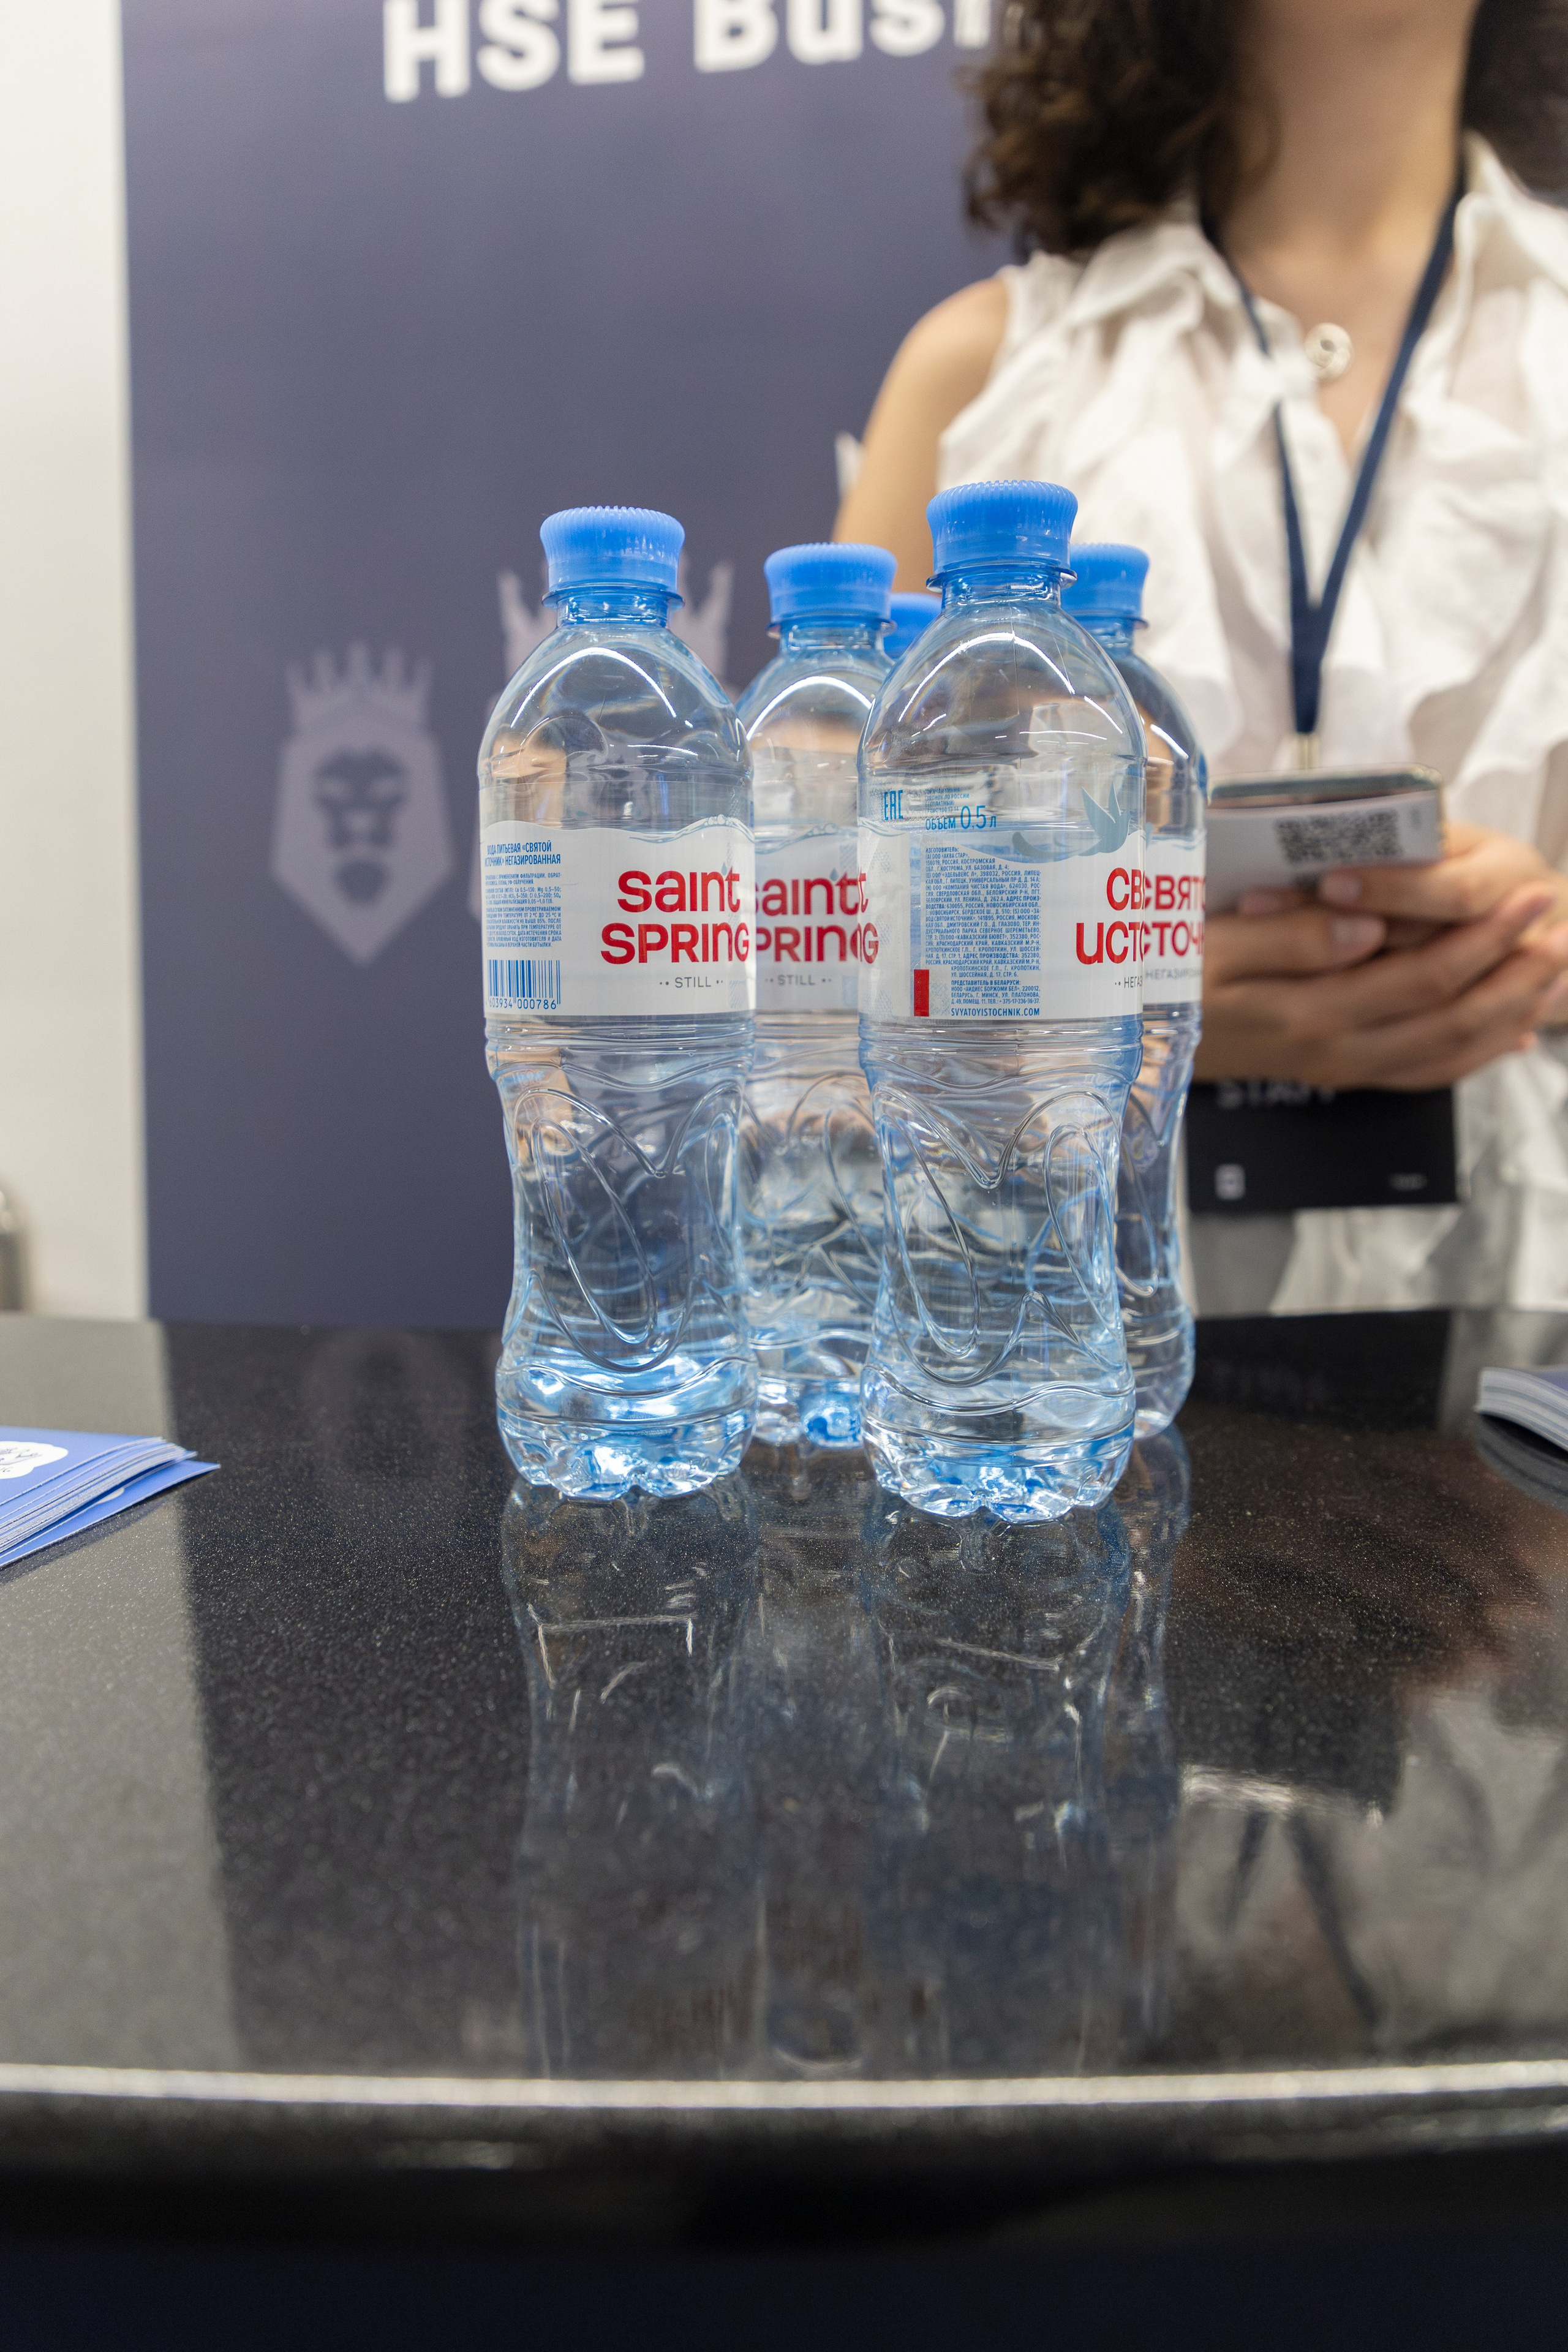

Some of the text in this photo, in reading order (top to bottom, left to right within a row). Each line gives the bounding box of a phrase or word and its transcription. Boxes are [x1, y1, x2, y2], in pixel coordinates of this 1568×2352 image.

[383, 0, 644, 103] HSE
[925, 817, 956, 831] ОБЪЕМ
[960, 805, 987, 830] 0,5
[497, 843, 521, 854] ПИТЬЕВАЯ
[522, 840, 552, 853] «СВЯТОЙ
[505, 854, 561, 865] НЕГАЗИРОВАННАЯ
[617, 866, 740, 913] saint
[755, 871, 858, 916] aint
[674, 977, 711, 988] STILL
[778, 974, 816, 986] STILL
[517, 998, 557, 1009] 000786
[951, 1008, 1040, 1016] SVYATOYISTOCHNIK.COM
